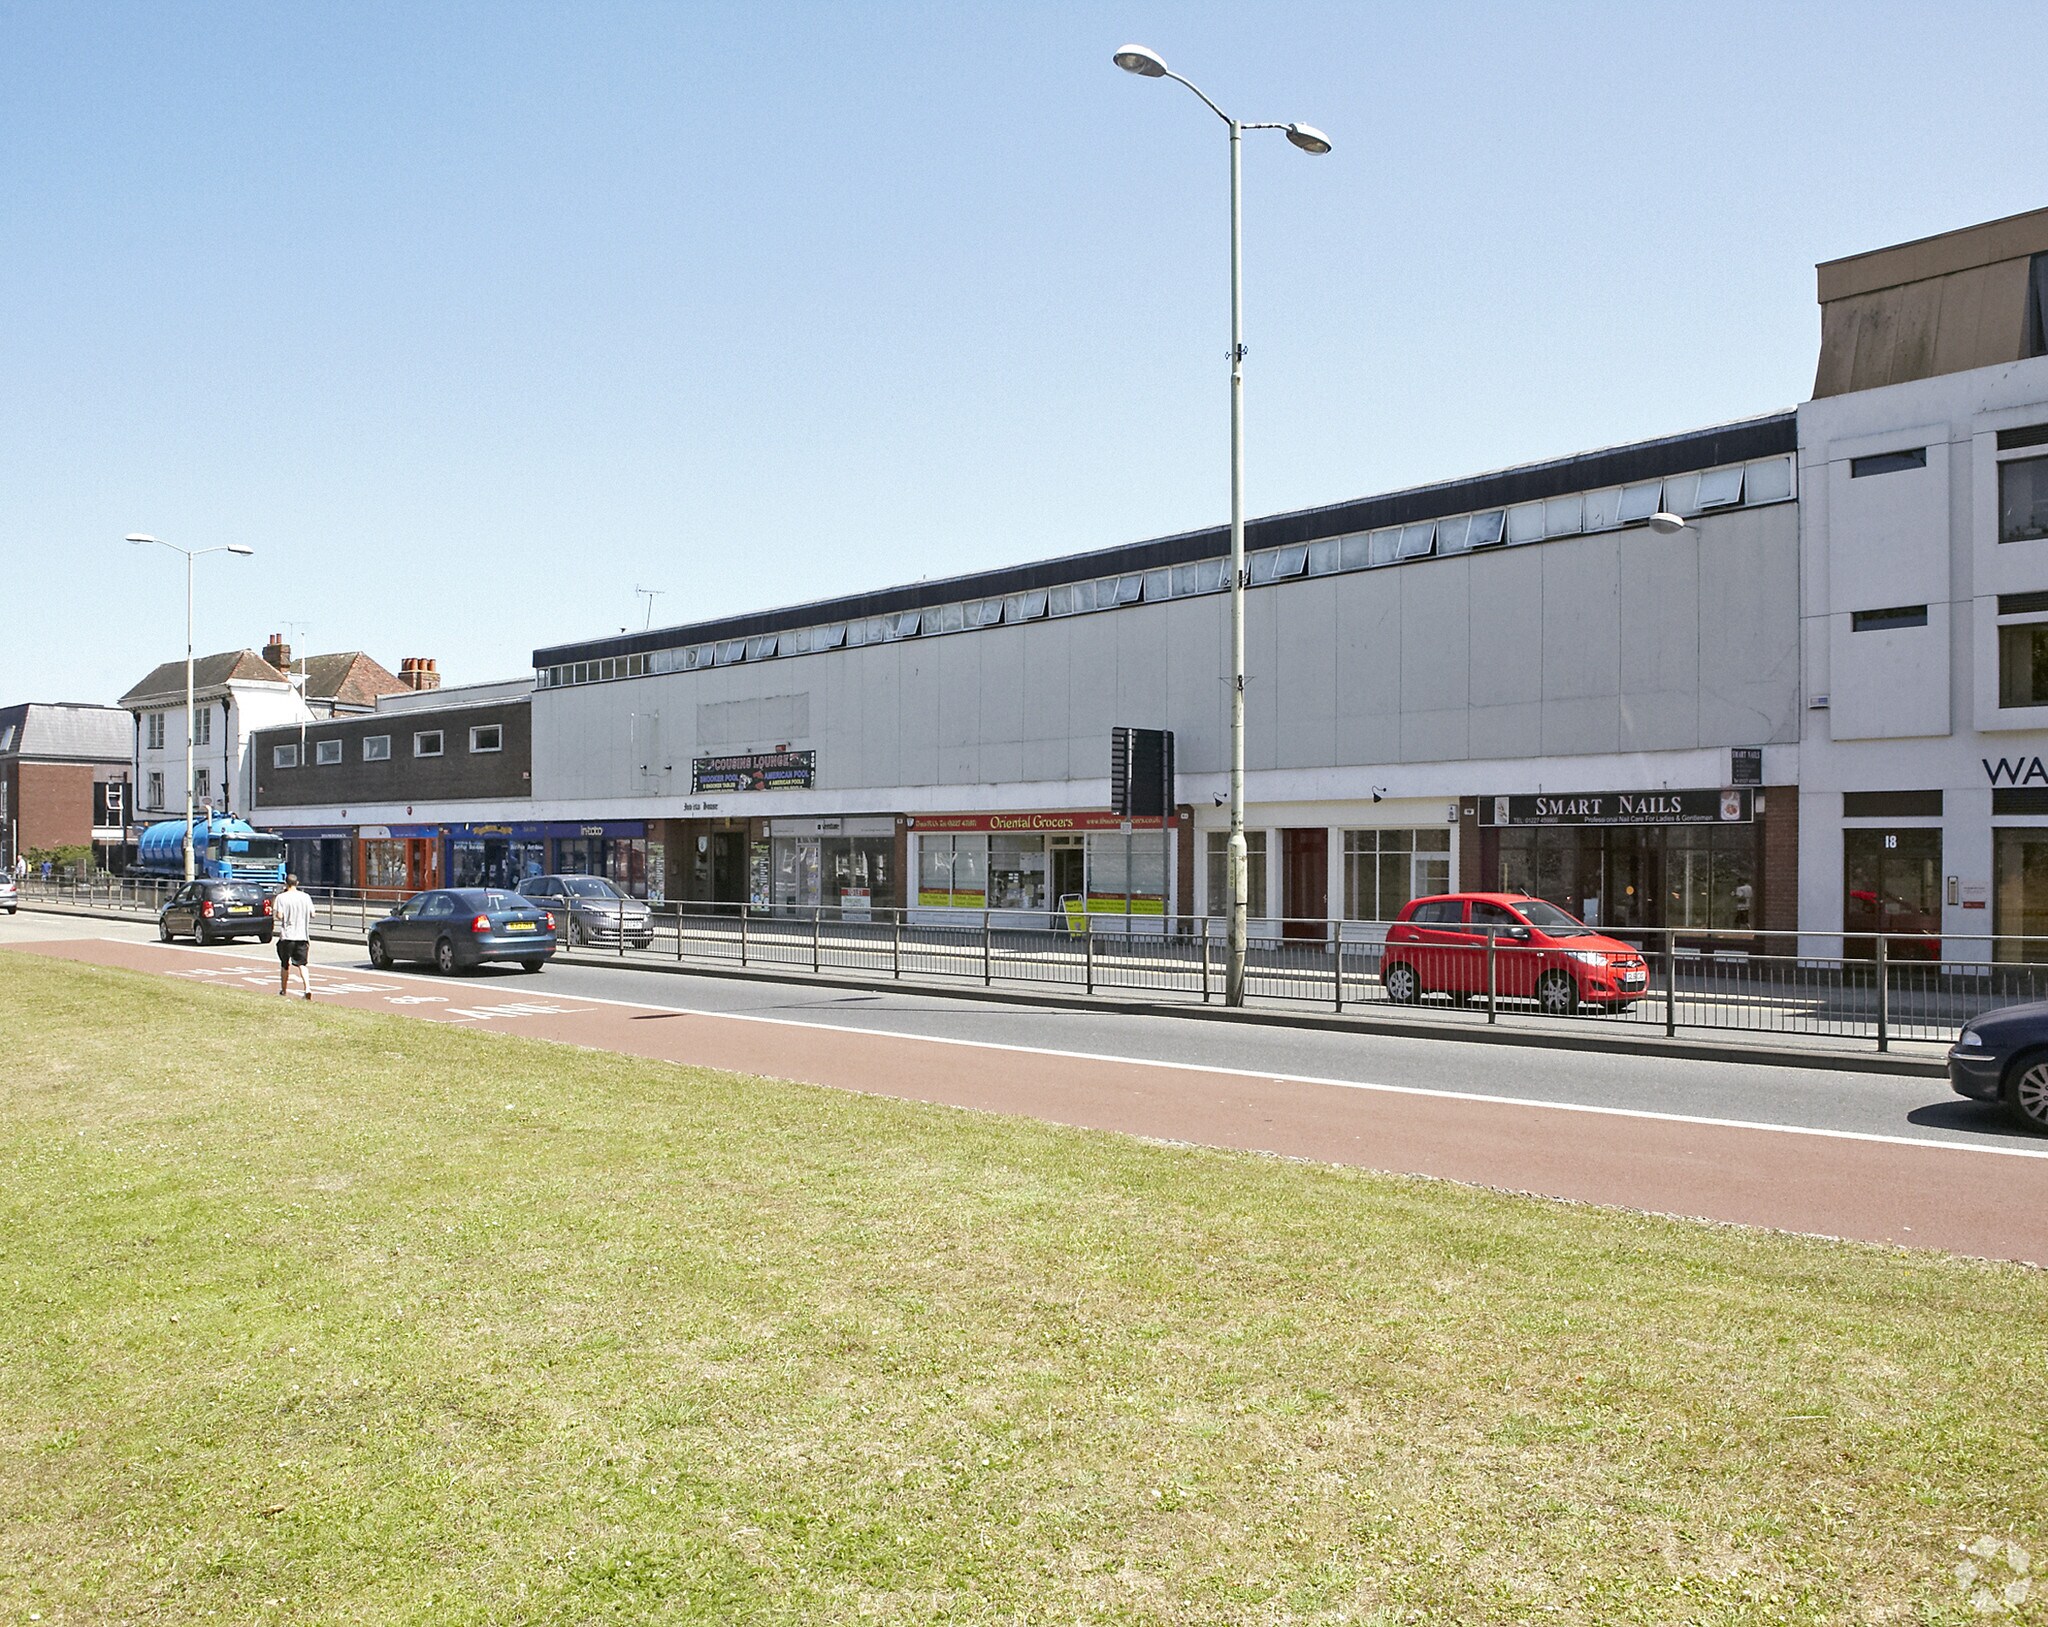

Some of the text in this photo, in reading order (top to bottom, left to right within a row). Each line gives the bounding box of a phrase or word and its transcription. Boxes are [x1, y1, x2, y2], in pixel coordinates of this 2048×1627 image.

[714, 754, 789, 771] COUSINS LOUNGE
[724, 773, 739, 782] POOL
[794, 770, 810, 778] POOL
[1535, 795, 1682, 816] SMART NAILS
[990, 815, 1031, 829] Oriental
[1032, 814, 1073, 829] Grocers
[1681, 814, 1714, 822] Gentlemen
[1884, 835, 1897, 848] 18
